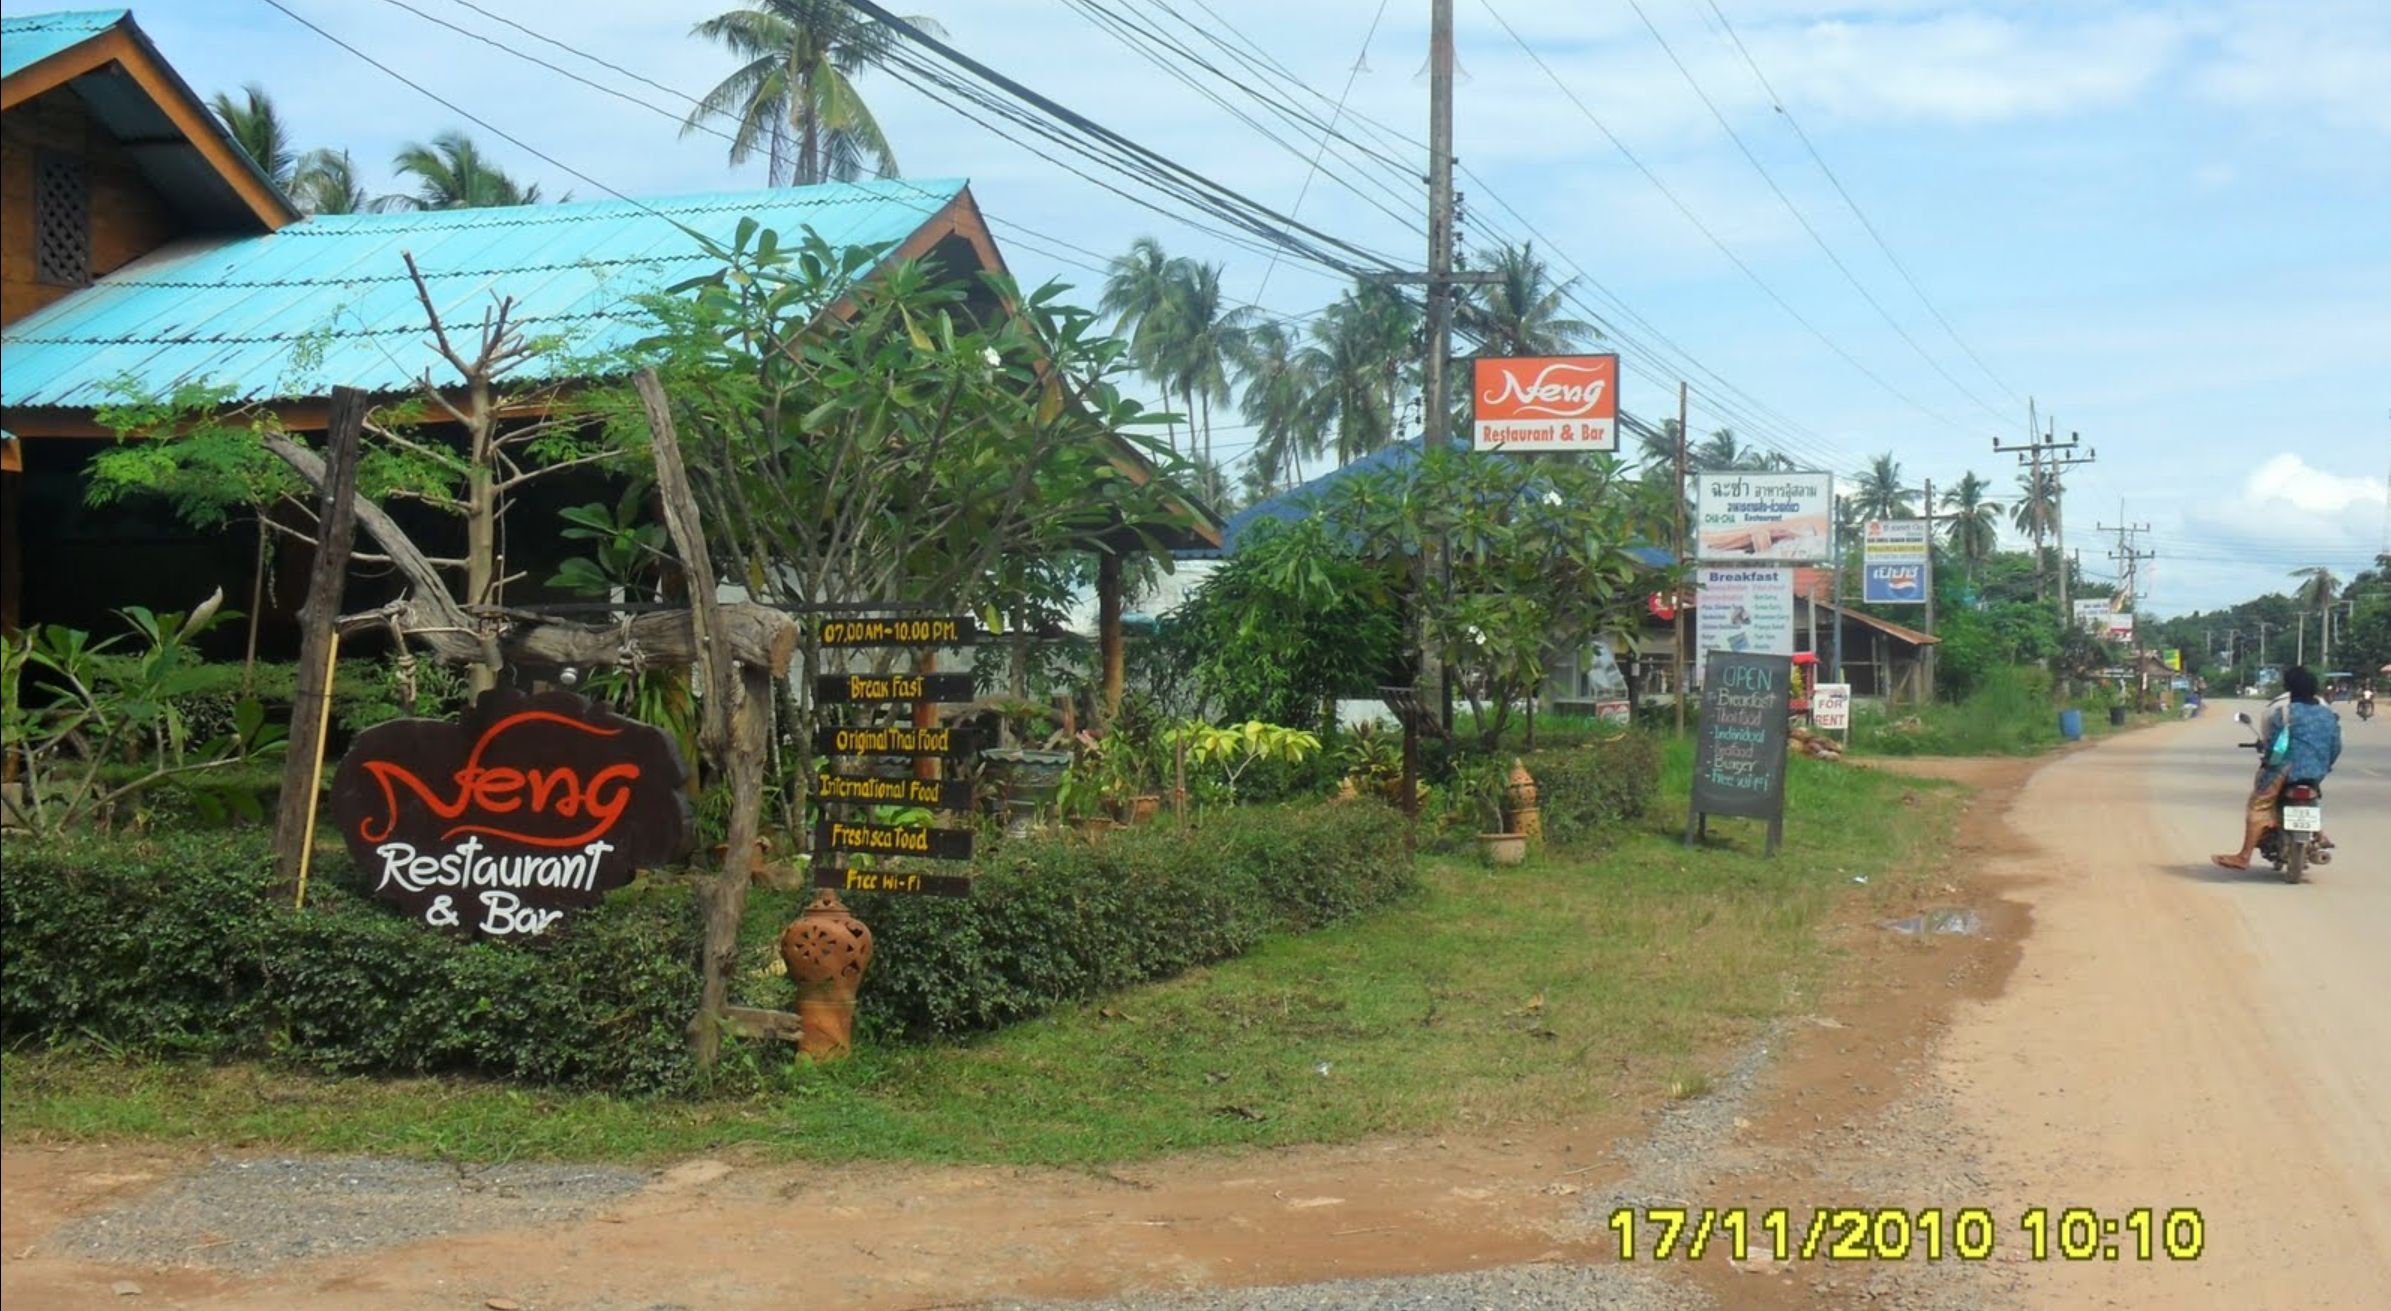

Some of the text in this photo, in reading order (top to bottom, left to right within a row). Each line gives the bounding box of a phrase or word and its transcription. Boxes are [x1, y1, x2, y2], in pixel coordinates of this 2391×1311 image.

[1483, 363, 1606, 416] Neng
[1483, 424, 1604, 442] Restaurant & Bar
[1709, 571, 1779, 581] Breakfast
[1723, 665, 1772, 691] OPEN
[1818, 699, 1843, 709] FOR
[1816, 714, 1845, 726] RENT
[836, 731, 888, 755] Original
[889, 729, 916, 750] Thai
[1714, 756, 1758, 774] Burger
[360, 710, 641, 847] Neng
[819, 774, 940, 803] International Food
[375, 835, 614, 892] Restaurant
[425, 890, 563, 936] & Bar
